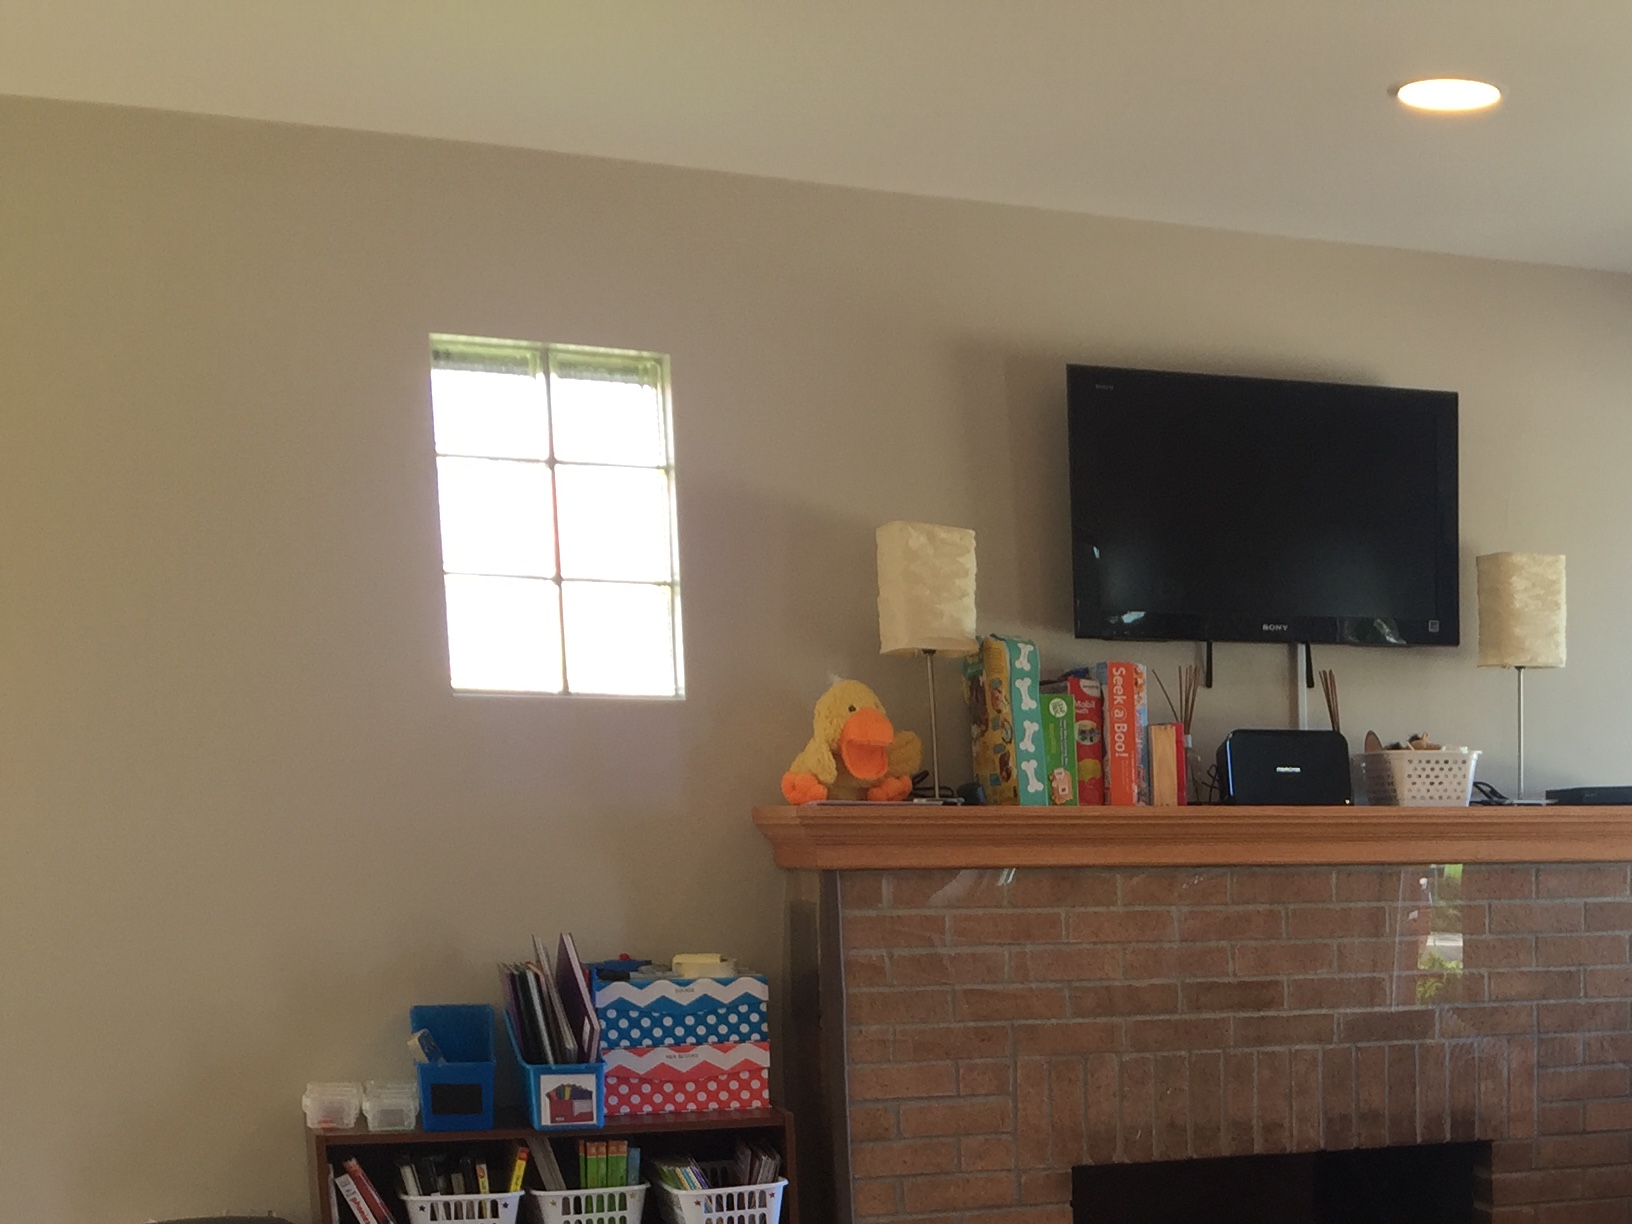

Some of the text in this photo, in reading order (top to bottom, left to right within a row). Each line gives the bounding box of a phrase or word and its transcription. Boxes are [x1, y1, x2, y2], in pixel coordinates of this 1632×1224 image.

[1262, 623, 1289, 632] SONY
[1112, 666, 1127, 705] Seek
[1114, 723, 1129, 758] Boo!
